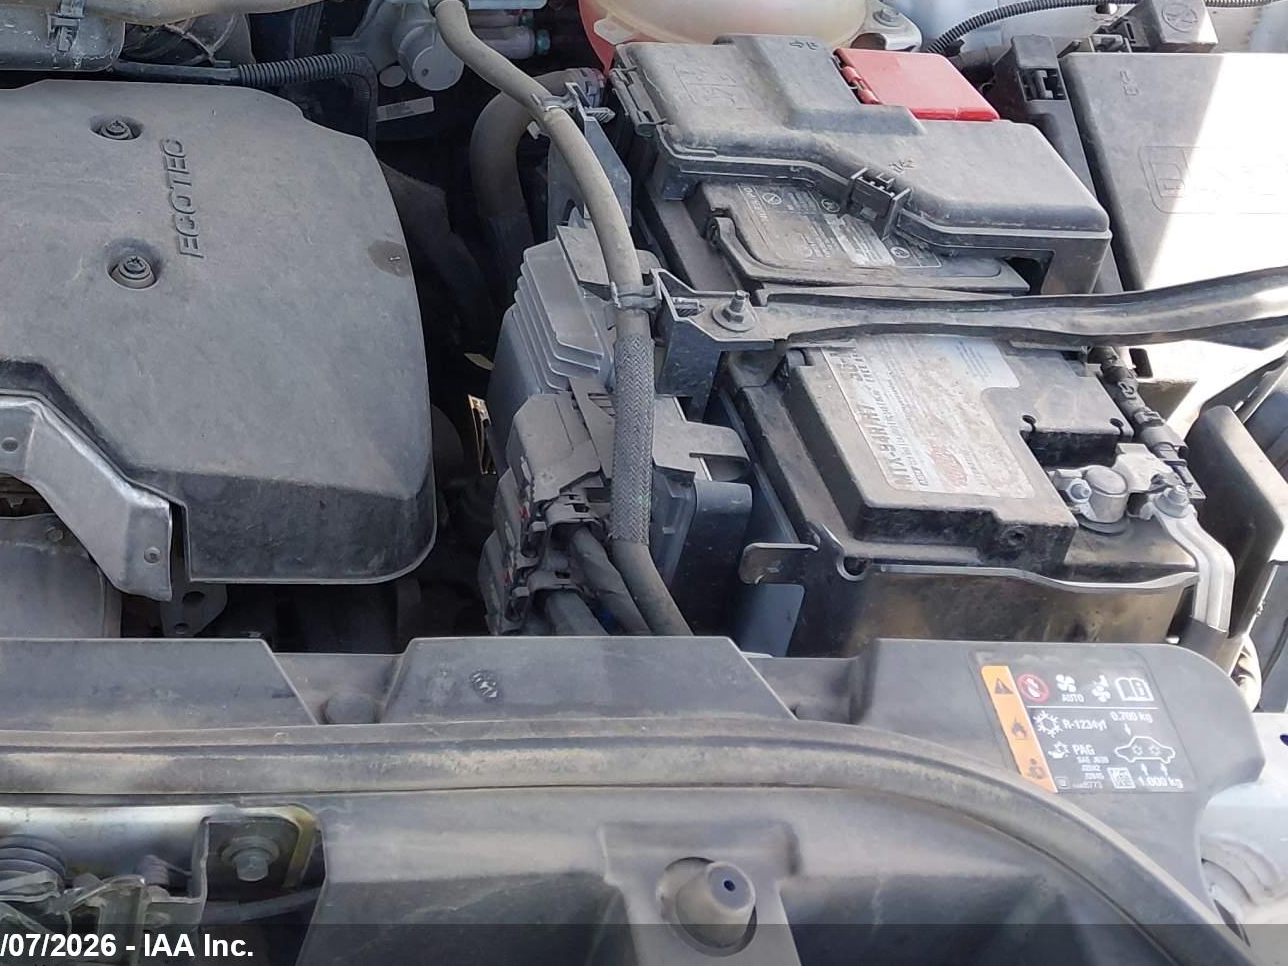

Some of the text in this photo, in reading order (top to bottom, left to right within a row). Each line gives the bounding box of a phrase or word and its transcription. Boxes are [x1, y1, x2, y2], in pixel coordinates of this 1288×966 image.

[160, 138, 205, 258] ECOTEC
[1062, 694, 1085, 702] AUTO
[1138, 712, 1153, 723] kg
[1072, 744, 1095, 755] PAG
[1167, 777, 1184, 789] kg
